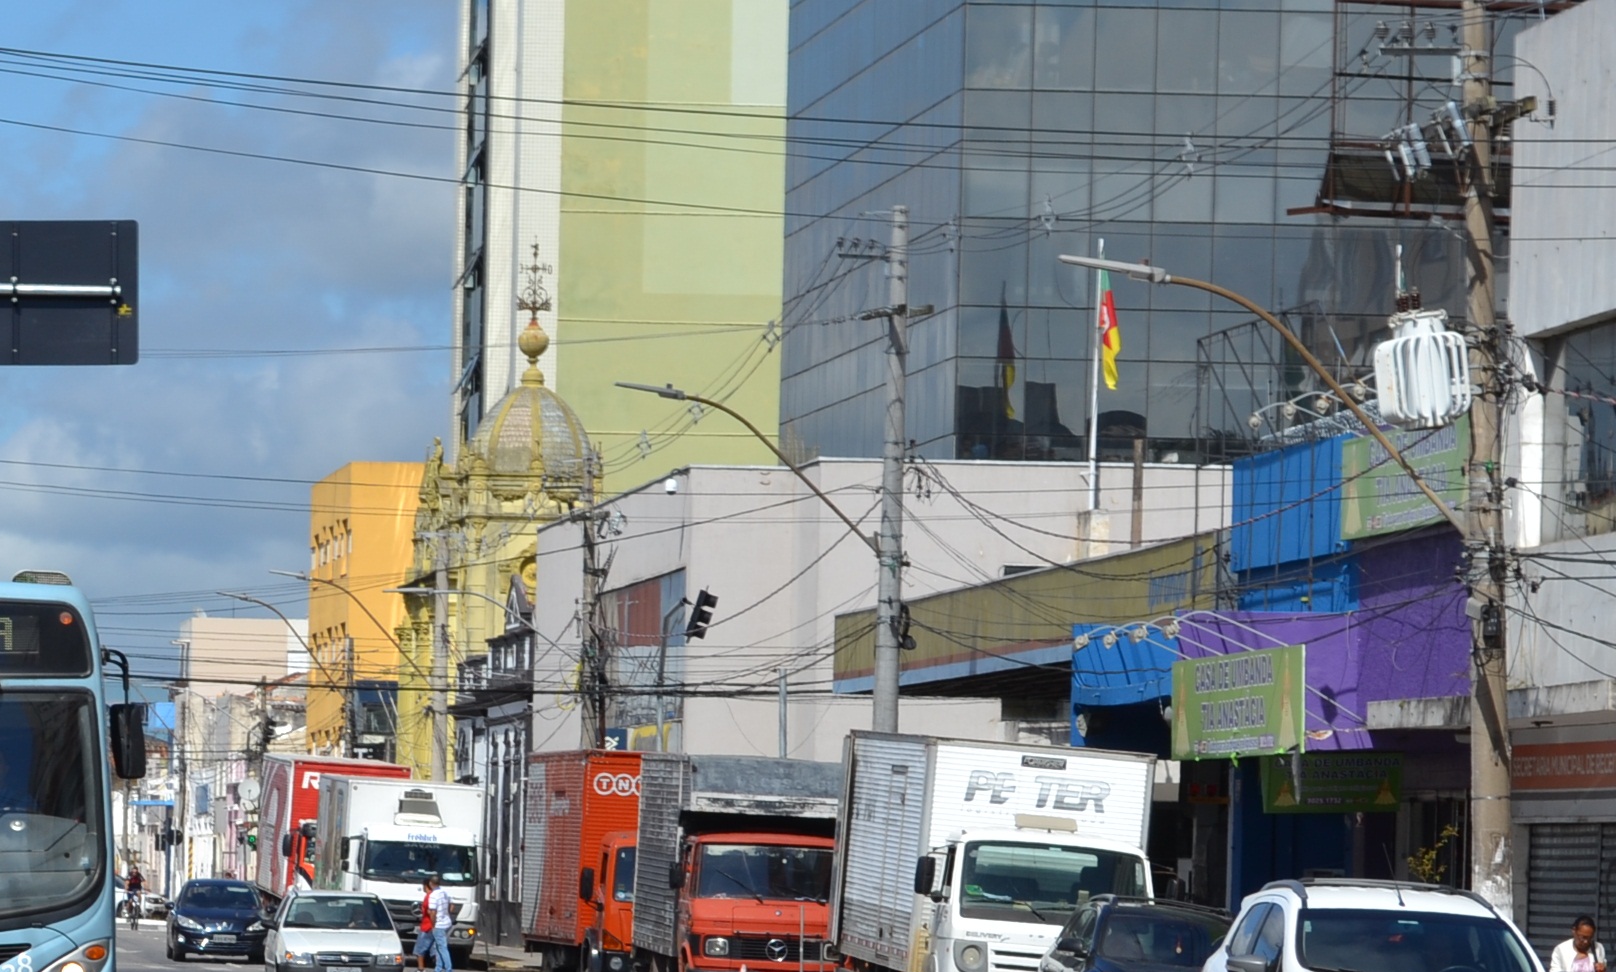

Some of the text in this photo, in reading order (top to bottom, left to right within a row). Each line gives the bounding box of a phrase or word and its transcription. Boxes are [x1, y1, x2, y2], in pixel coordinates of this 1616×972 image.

[1195, 653, 1274, 694] CASA DE UMBANDA
[1201, 701, 1215, 732] TIA
[1274, 757, 1401, 768] CAA DE UMBANDA
[596, 775, 641, 793] TN
[1286, 770, 1308, 780] TA
